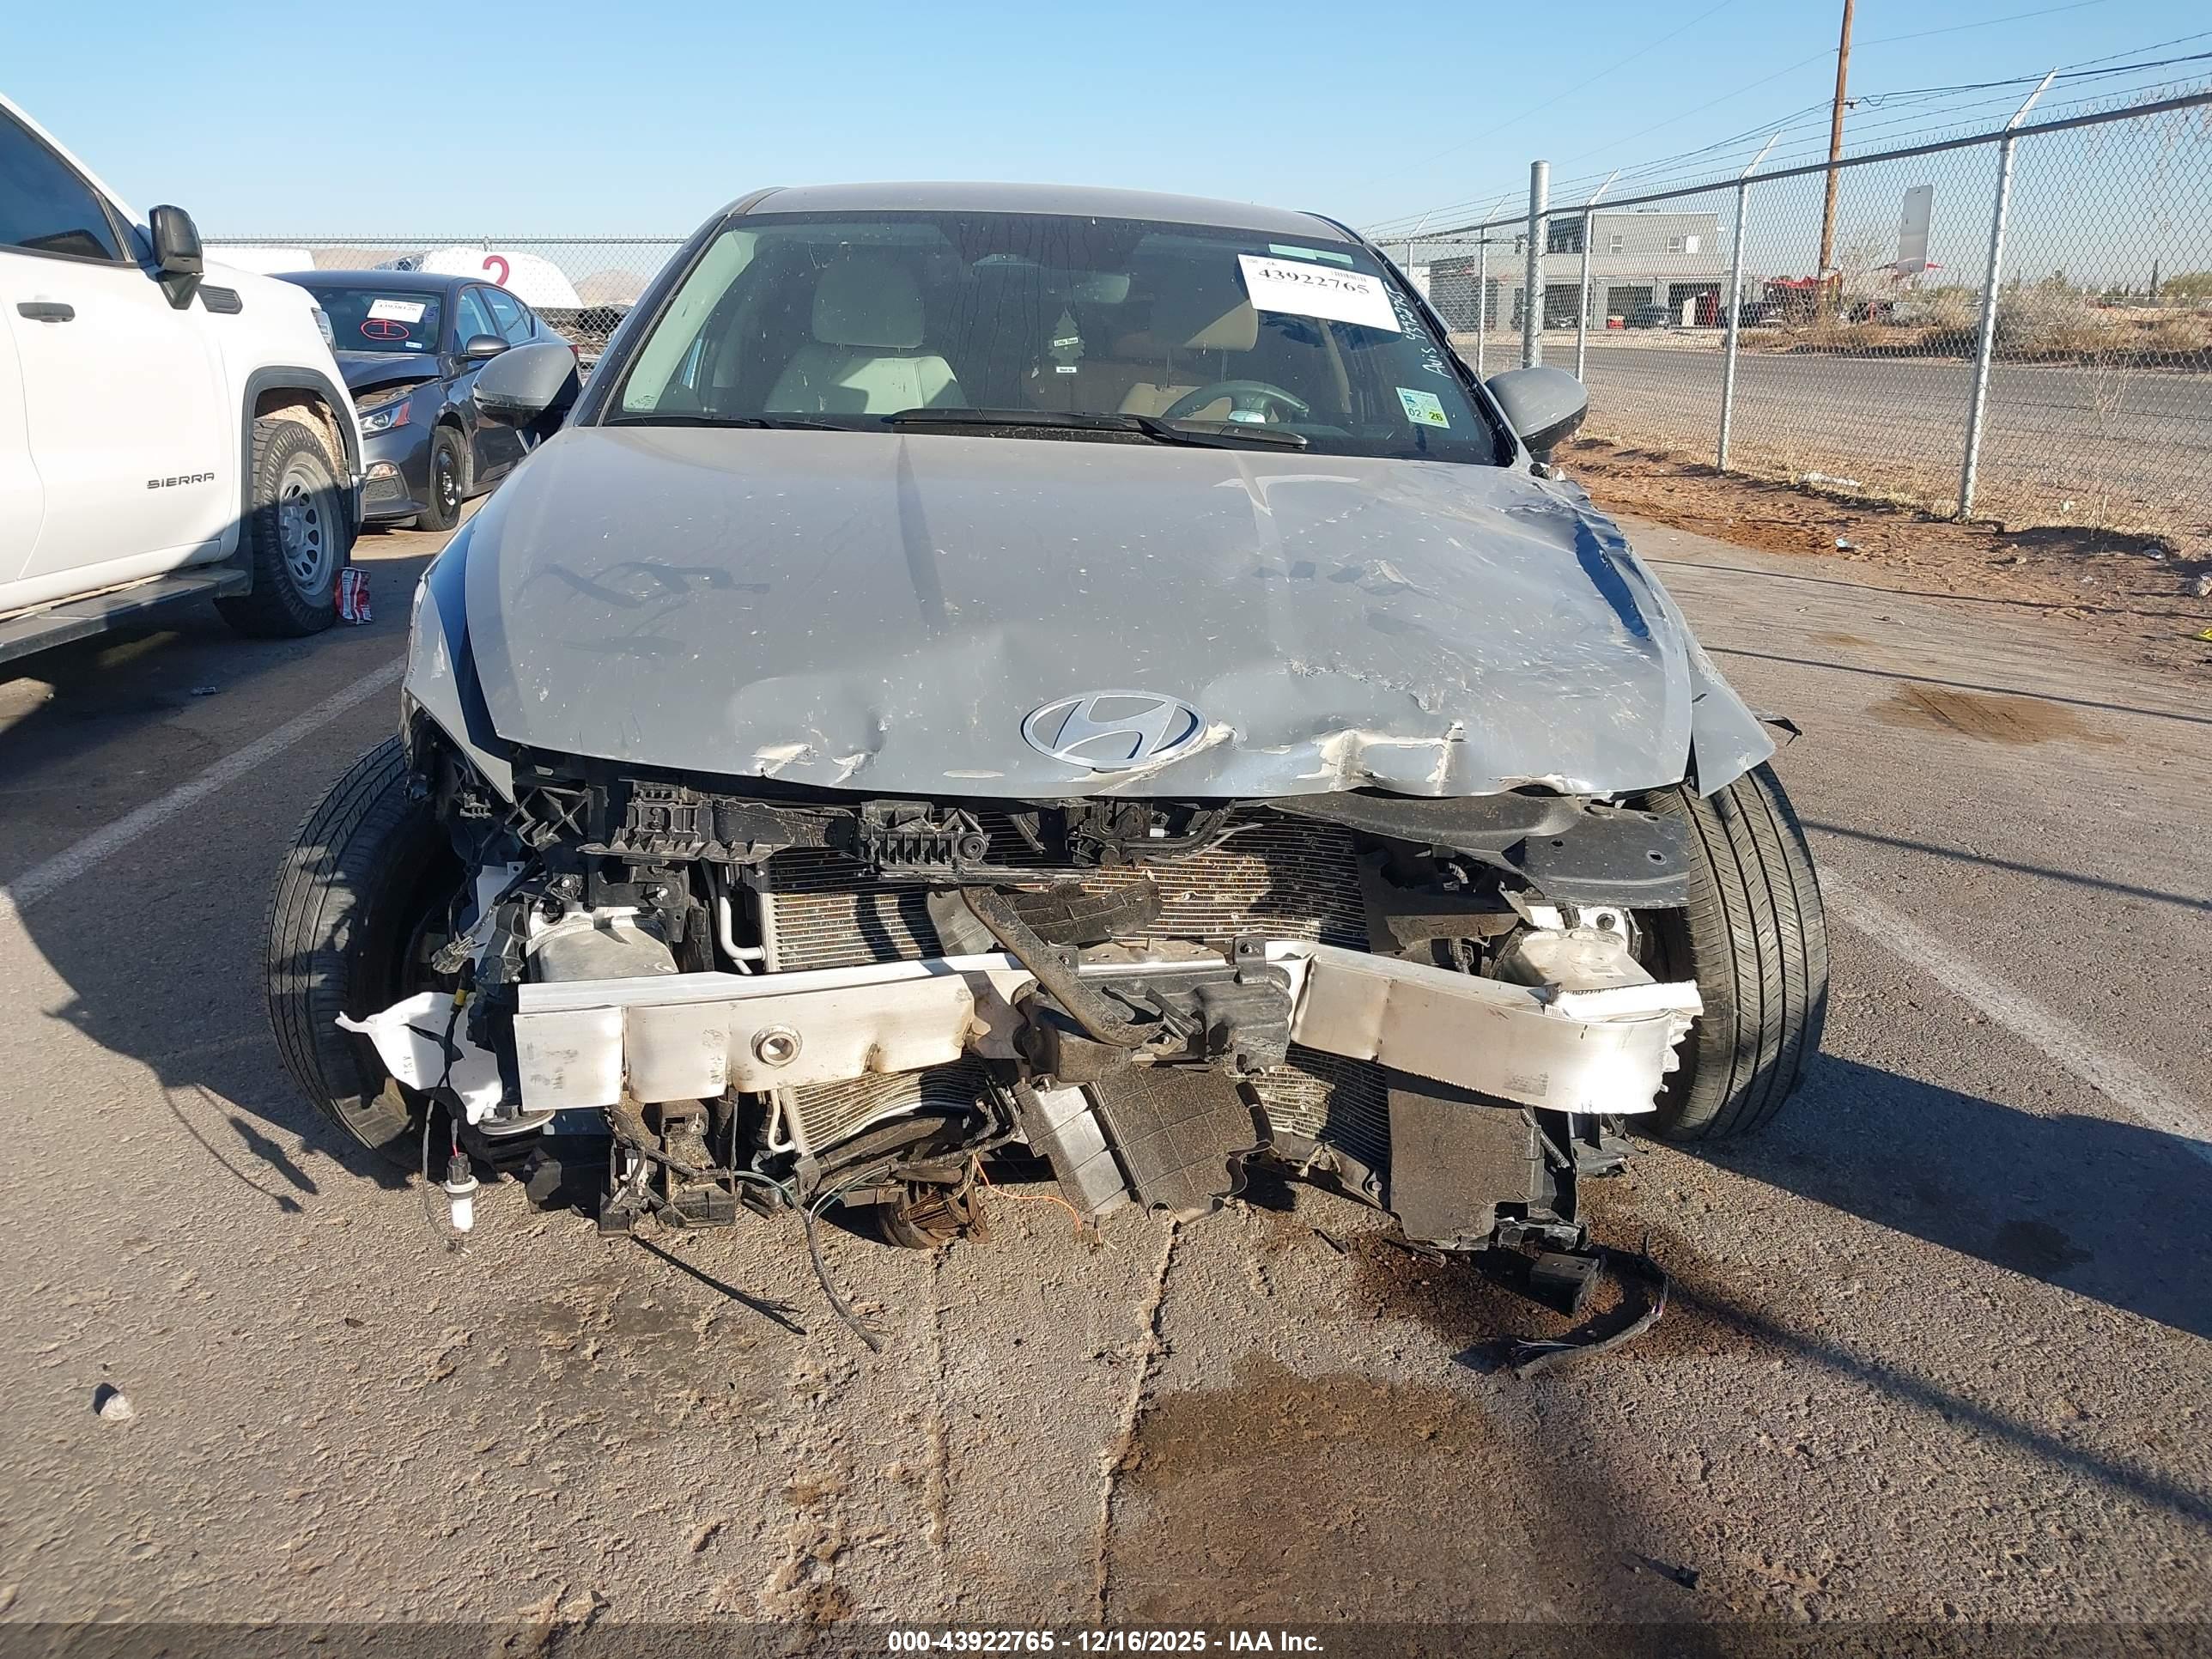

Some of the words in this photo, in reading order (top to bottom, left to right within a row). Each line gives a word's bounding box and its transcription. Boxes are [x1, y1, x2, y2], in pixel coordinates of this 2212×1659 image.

[1258, 268, 1370, 295] 43922765
[1408, 408, 1422, 418] 02
[1429, 411, 1443, 422] 26
[146, 471, 215, 489] SIERRA
